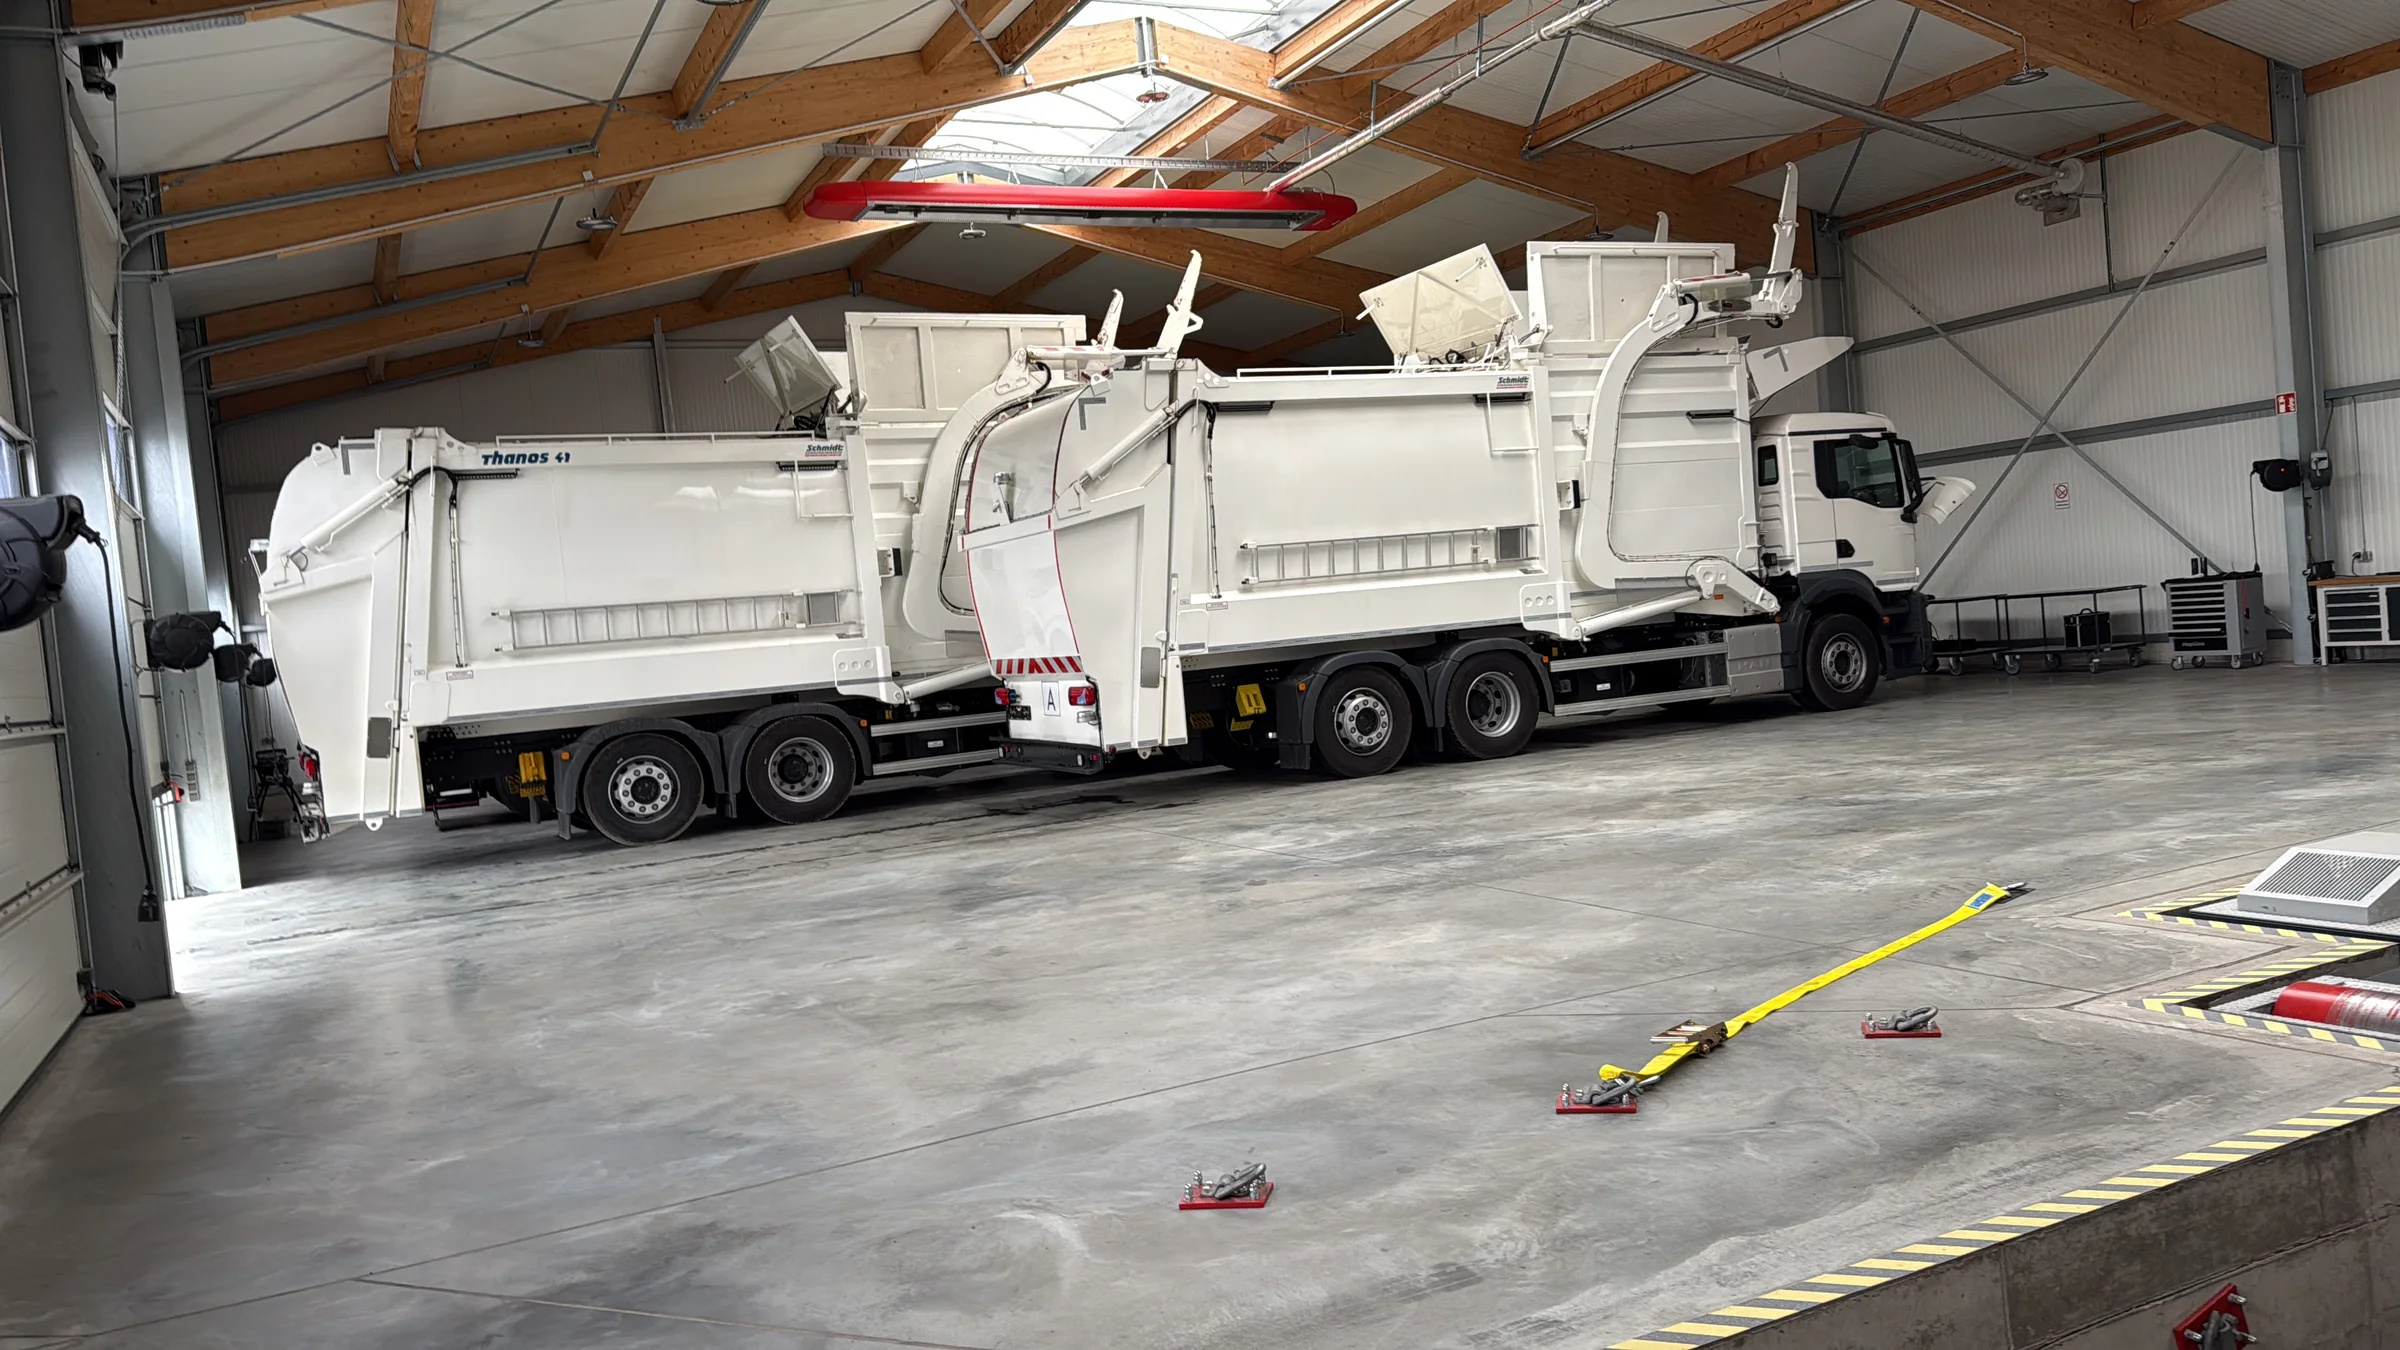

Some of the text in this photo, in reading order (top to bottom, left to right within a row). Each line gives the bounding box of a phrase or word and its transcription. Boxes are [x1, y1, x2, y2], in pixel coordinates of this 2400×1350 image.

[1498, 376, 1529, 384] Schmidt
[806, 444, 844, 452] Schmidt
[481, 450, 571, 465] Thanos 41
[1047, 687, 1057, 711] A
